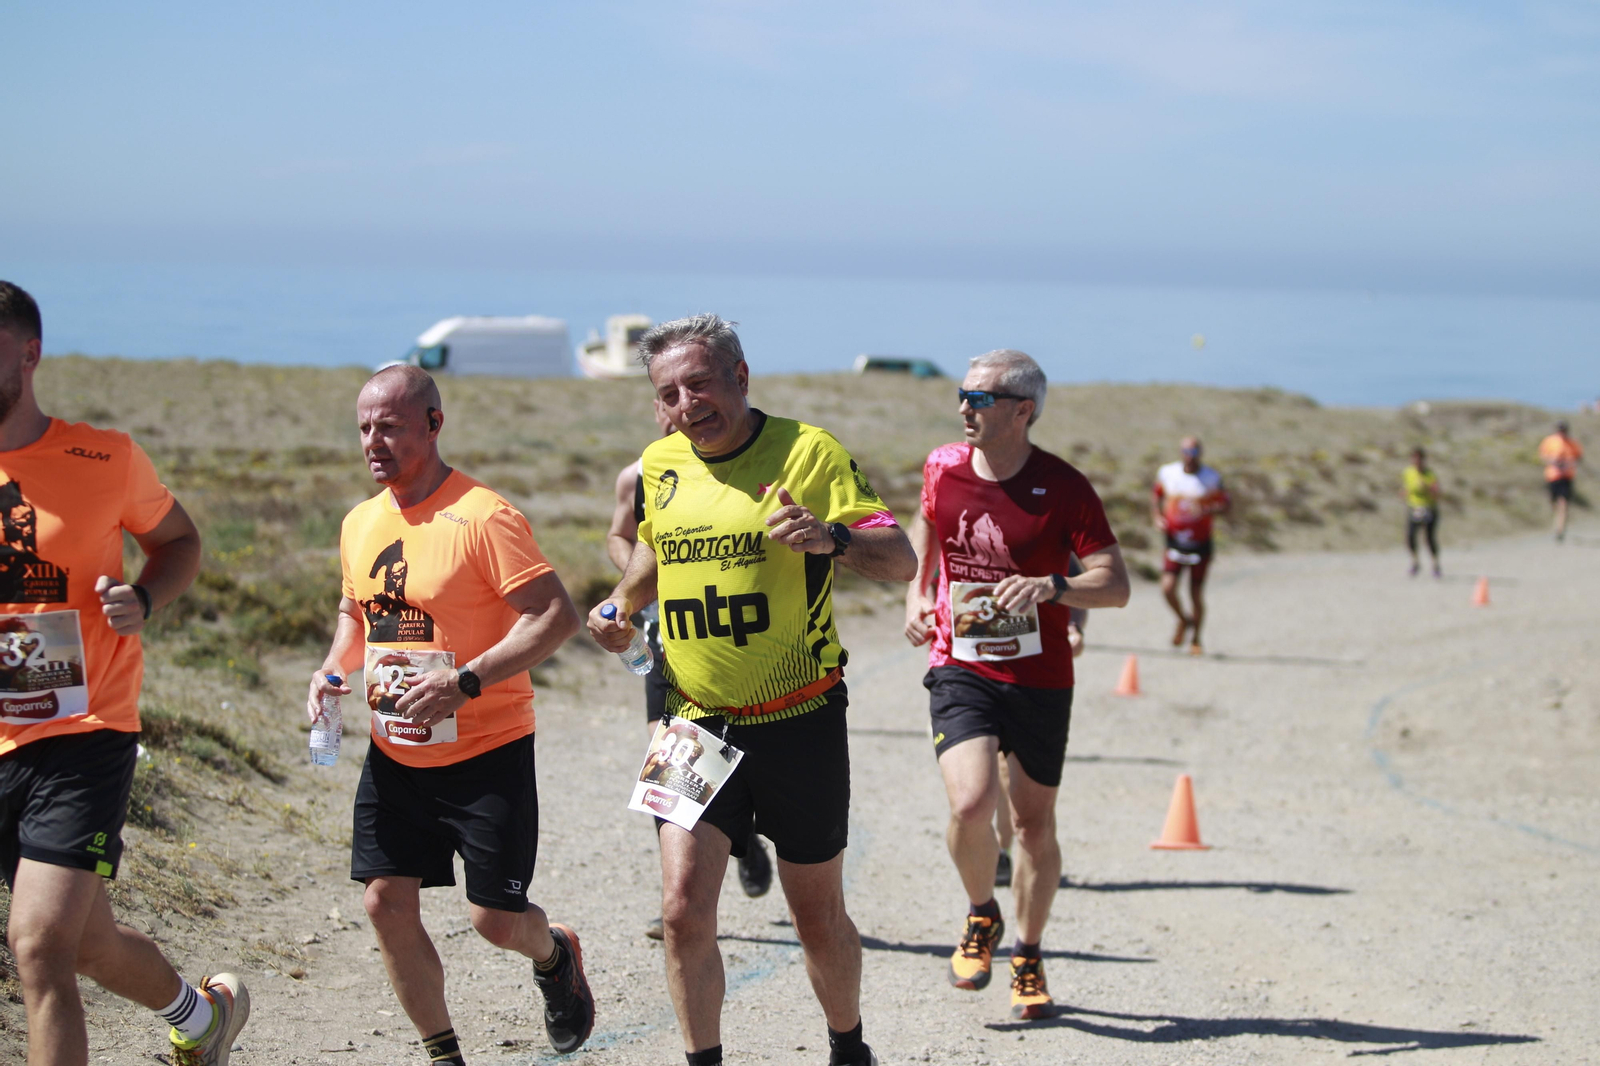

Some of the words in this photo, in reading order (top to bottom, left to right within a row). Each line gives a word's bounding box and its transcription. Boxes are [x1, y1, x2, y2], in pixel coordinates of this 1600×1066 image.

[655, 531, 673, 544] Centro
[675, 525, 713, 538] Deportivo
[662, 531, 765, 565] SPORTGYM
[23, 563, 59, 578] XIII
[720, 560, 731, 571] El
[733, 556, 767, 569] Alquián
[399, 609, 425, 621] XIII
[664, 585, 770, 647] mtp
[398, 622, 426, 630] CARRERA
[3, 632, 47, 667] 32
[658, 733, 695, 767] 30
